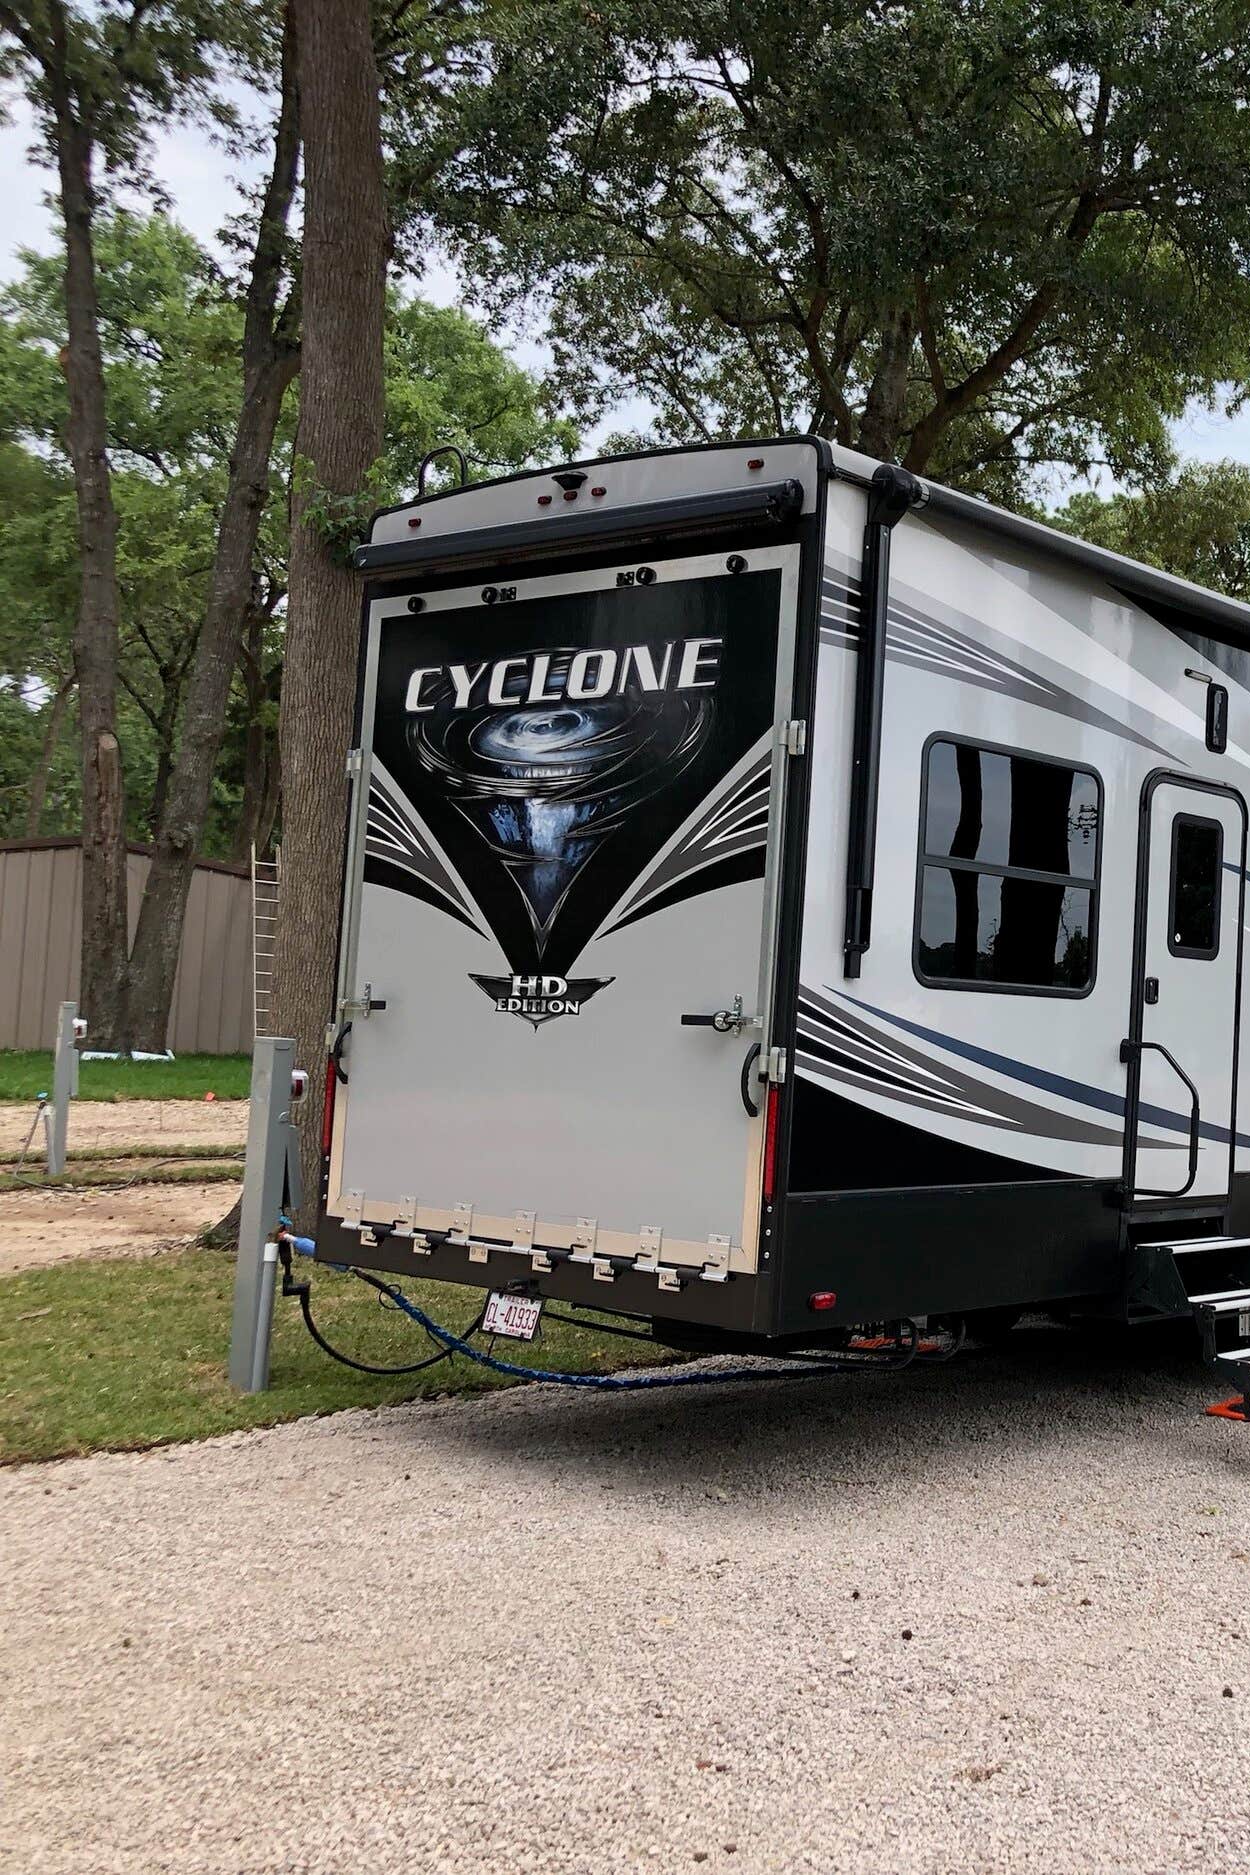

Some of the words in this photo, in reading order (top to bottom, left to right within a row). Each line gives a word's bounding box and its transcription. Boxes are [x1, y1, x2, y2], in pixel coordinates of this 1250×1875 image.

[405, 637, 723, 713] CYCLONE
[510, 974, 568, 997] HD
[496, 997, 580, 1015] EDITION
